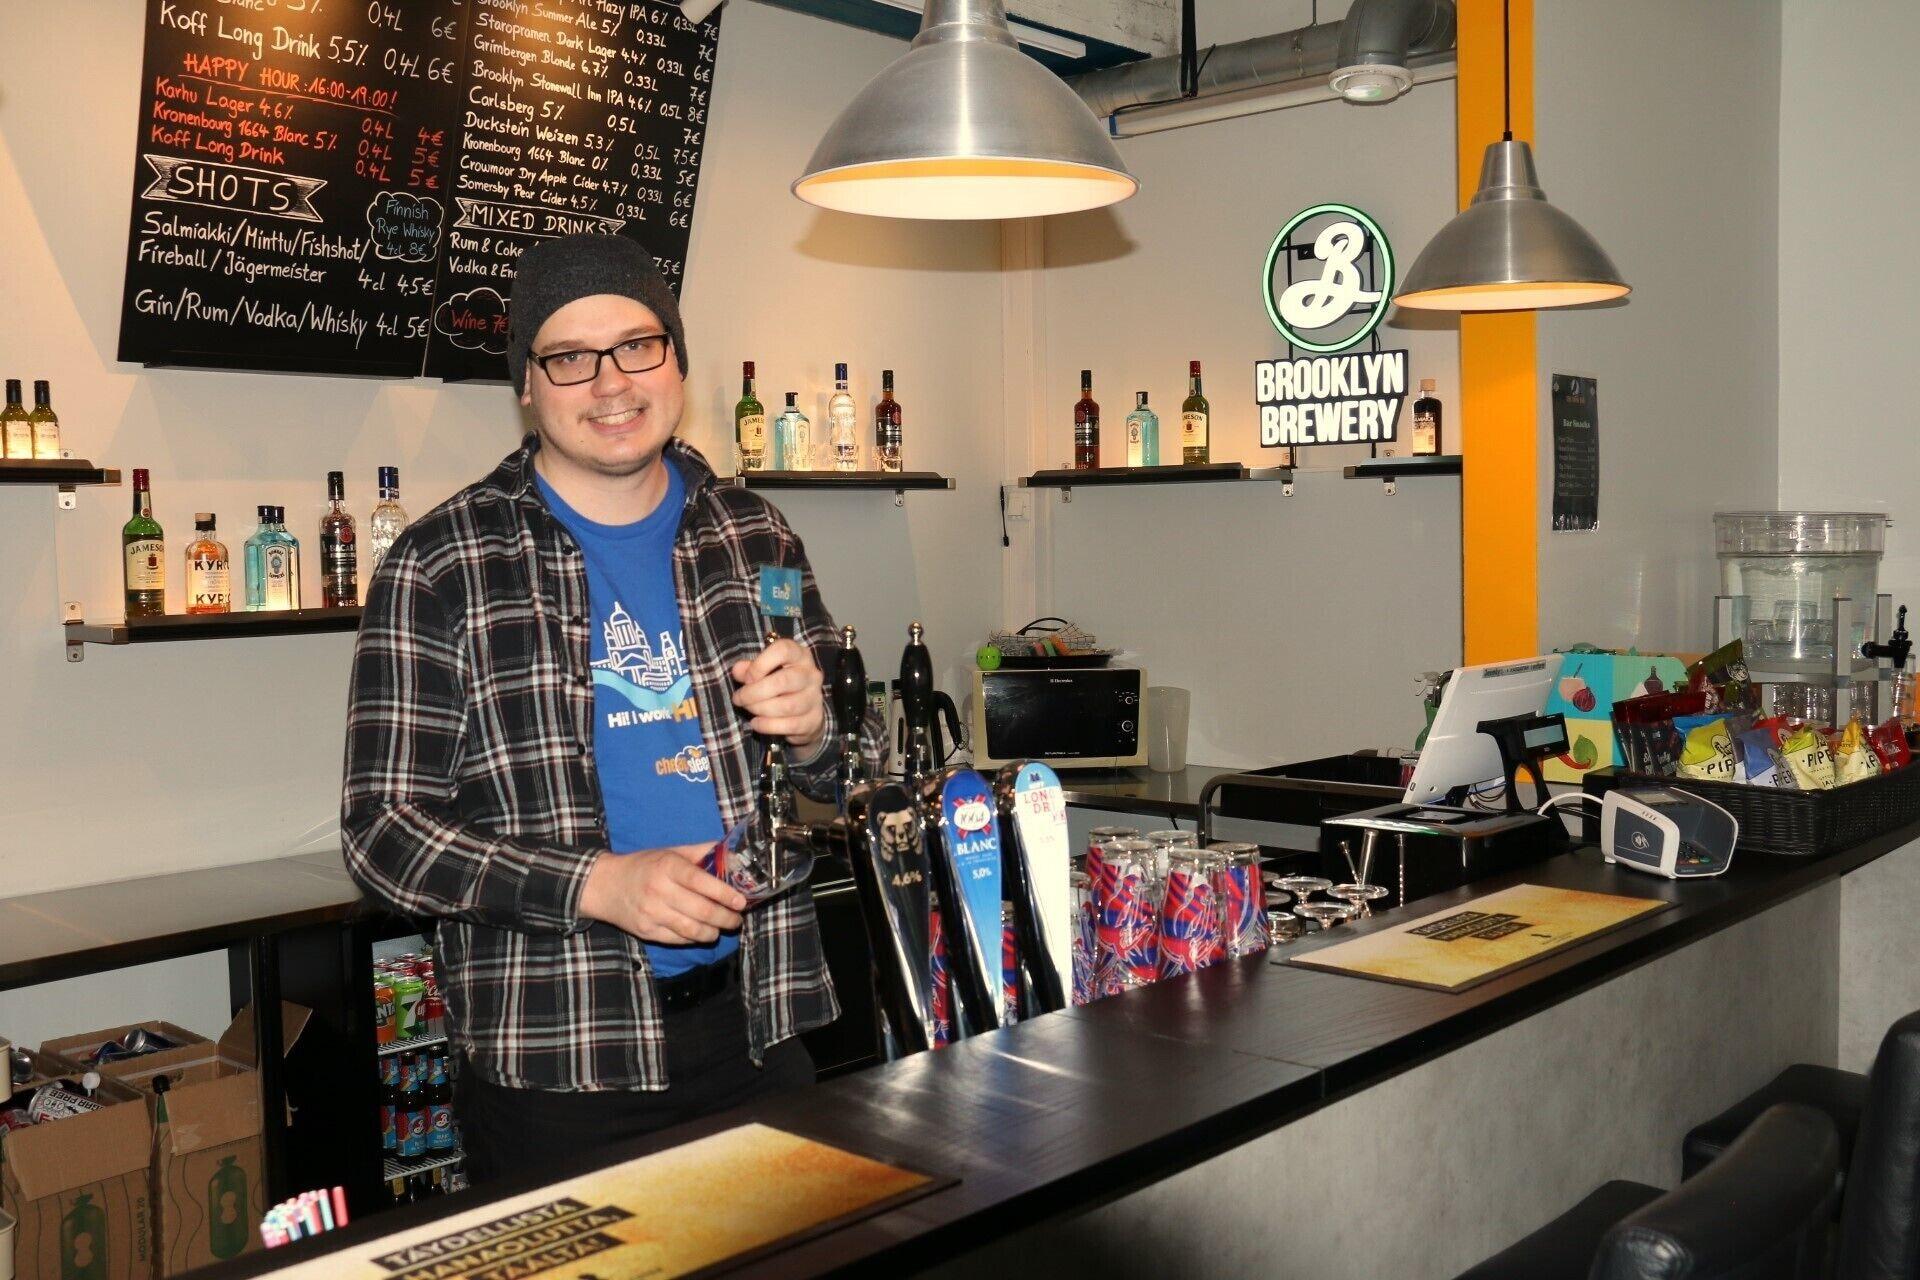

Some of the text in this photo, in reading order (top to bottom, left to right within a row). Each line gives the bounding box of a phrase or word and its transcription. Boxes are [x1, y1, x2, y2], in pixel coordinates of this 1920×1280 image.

[160, 1, 208, 36] Koff
[217, 16, 263, 60] Long
[271, 26, 320, 59] Drink
[428, 57, 455, 84] 6€
[431, 16, 457, 40] 6€
[477, 0, 528, 18] rooklyn
[531, 3, 574, 24] Summer
[575, 12, 598, 30] Ale
[600, 19, 621, 37] 5%
[698, 44, 714, 62] 7€
[629, 4, 647, 23] IPA
[651, 10, 669, 26] 6%
[703, 22, 719, 41] 7€
[183, 53, 249, 82] HAPPY
[475, 13, 552, 43] Staropramen
[556, 31, 584, 51] Dark
[588, 38, 617, 63] Lager
[693, 65, 710, 83] 6€
[474, 34, 537, 66] Grimbergen
[540, 50, 576, 71] Blonde
[689, 86, 706, 106] 7€
[155, 76, 198, 104] Karhu
[206, 85, 254, 119] Lager
[417, 126, 444, 147] 4€
[471, 59, 524, 92] Brooklyn
[530, 72, 582, 99] Stonewall
[587, 85, 602, 103] Inn
[607, 88, 624, 107] IPA
[687, 106, 705, 125] 8€
[153, 100, 233, 139] Kronenbourg
[238, 119, 270, 138] 1664
[272, 125, 309, 146] Blanc
[313, 131, 338, 151] 5%
[411, 147, 440, 168] 5€
[463, 111, 530, 138] Duckstein
[536, 124, 579, 146] Weizen
[469, 86, 534, 122] Carlsberg
[539, 101, 565, 121] 5%
[682, 128, 701, 145] 7€
[151, 124, 191, 149] Koff
[195, 132, 234, 163] Long
[238, 141, 285, 165] Drink
[407, 168, 440, 189] 5€
[462, 131, 521, 162] Kronenbourg
[527, 146, 554, 163] 1664
[557, 150, 586, 167] Blanc
[591, 156, 609, 171] 0%
[675, 170, 696, 187] 5€
[168, 166, 292, 211] SHOTS
[456, 175, 510, 199] Somersby
[513, 183, 536, 199] Pear
[540, 189, 567, 206] Cider
[669, 211, 689, 228] 6€
[460, 155, 515, 177] Crowmoor
[517, 167, 537, 186] Dry
[538, 169, 568, 187] Apple
[573, 174, 600, 191] Cider
[673, 190, 692, 208] 6€
[385, 199, 429, 220] Finnish
[471, 204, 607, 236] MIXED DRINKS
[376, 217, 436, 244] Rye Whisky
[409, 242, 426, 255] 8€
[450, 231, 479, 252] Rum
[481, 237, 491, 253] &
[495, 240, 524, 257] Coke
[357, 268, 386, 291] 4cl
[449, 256, 488, 276] Vodka
[490, 263, 499, 276] &
[376, 313, 398, 337] 4cl
[404, 316, 430, 339] 5€
[451, 309, 487, 330] Wine
[1256, 352, 1404, 403] BROOKLYN
[1261, 398, 1399, 446] BREWERY
[607, 711, 631, 728] Hi!
[956, 837, 997, 856] BLANC
